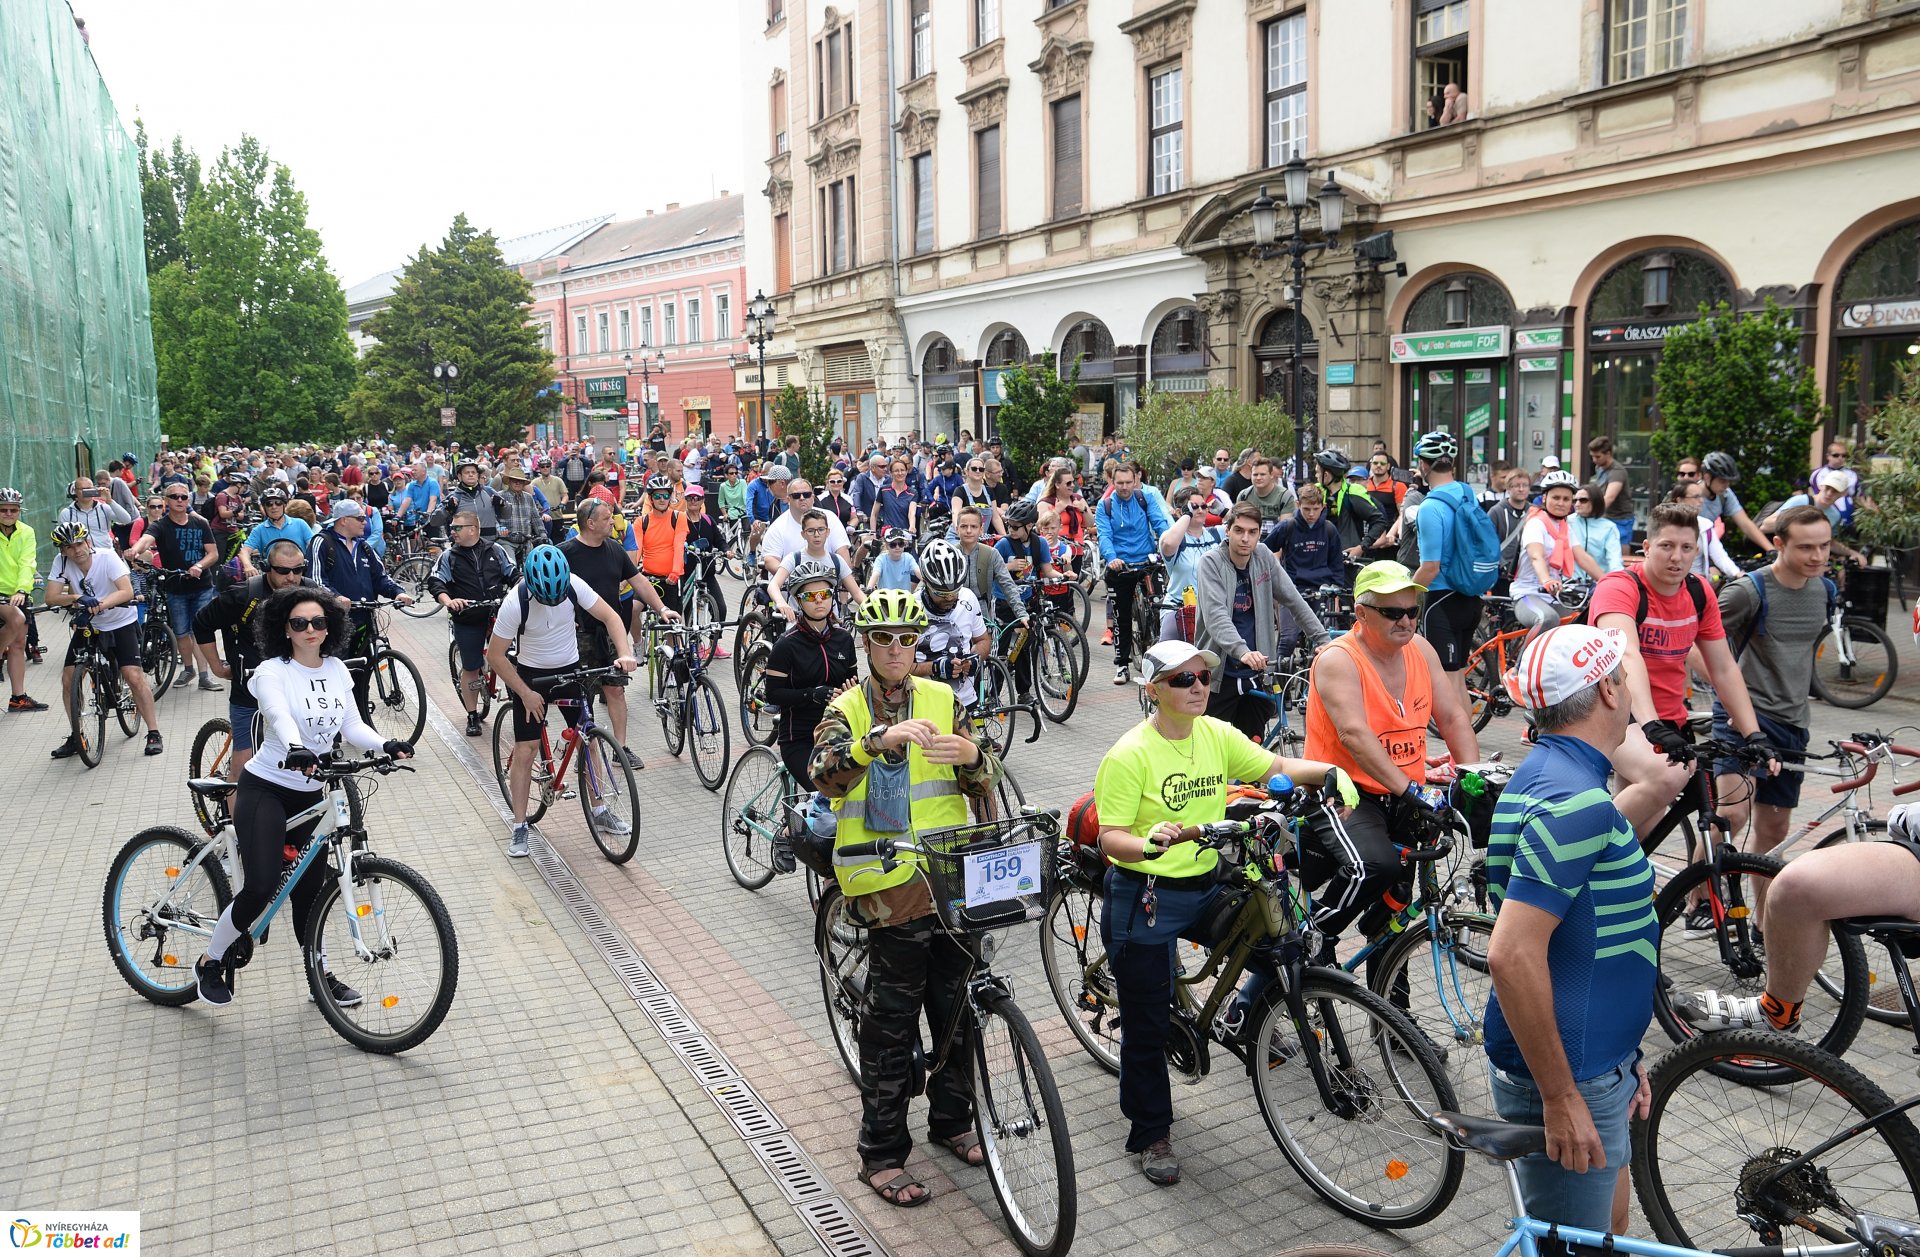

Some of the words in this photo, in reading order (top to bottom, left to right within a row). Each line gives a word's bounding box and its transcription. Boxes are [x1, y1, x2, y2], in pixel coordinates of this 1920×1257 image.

[1476, 335, 1499, 349] FDF
[589, 378, 621, 392] NYÍRSÉG
[1572, 638, 1604, 668] Cilo
[1583, 649, 1617, 684] aufina
[310, 679, 327, 693] IT
[868, 785, 908, 801] AUCHAN
[978, 851, 1006, 862] DECATHLON
[982, 856, 1022, 883] 159
